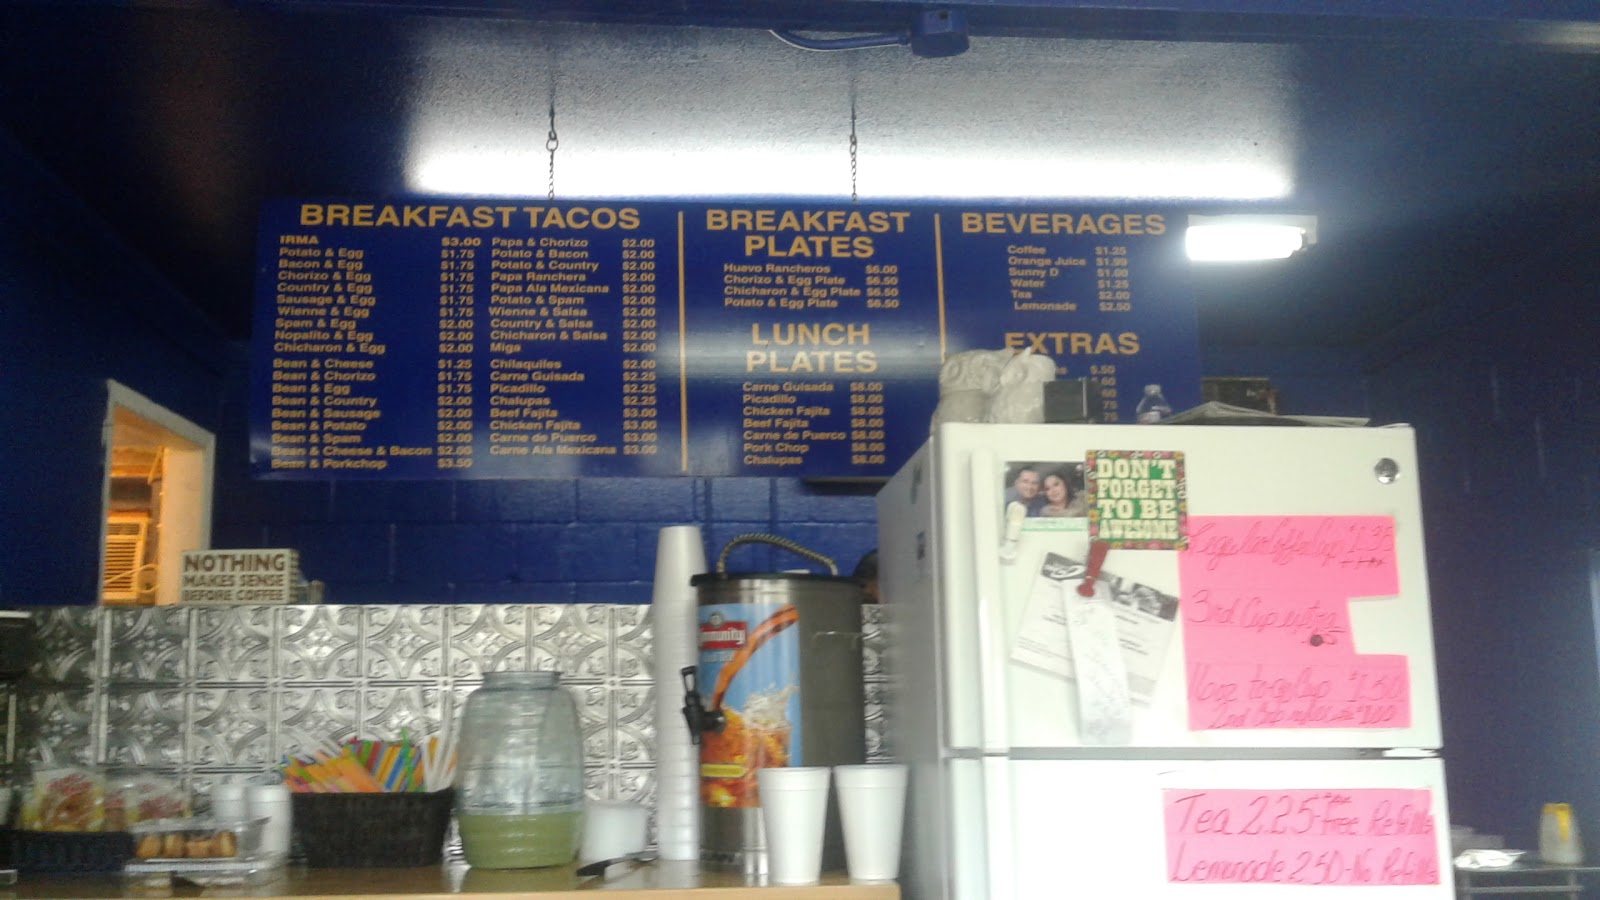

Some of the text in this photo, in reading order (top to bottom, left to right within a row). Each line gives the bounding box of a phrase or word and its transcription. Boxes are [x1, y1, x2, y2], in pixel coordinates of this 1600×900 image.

[301, 205, 640, 229] BREAKFAST TACOS
[706, 210, 910, 232] BREAKFAST
[961, 212, 1165, 235] BEVERAGES
[280, 235, 318, 245] IRMA
[491, 237, 588, 249] Papa & Chorizo
[745, 236, 874, 258] PLATES
[1008, 245, 1046, 255] Coffee
[279, 247, 364, 260] Potato & Egg
[491, 249, 589, 259] Potato & Bacon
[278, 259, 363, 272] Bacon & Egg
[491, 261, 599, 273] Potato & Country
[723, 263, 831, 274] Huevo Rancheros
[1008, 257, 1087, 269] Orange Juice
[277, 271, 372, 284] Chorizo & Egg
[491, 272, 586, 284] Papa Ranchera
[1008, 267, 1059, 279] Sunny D
[723, 275, 846, 287] Chorizo & Egg Plate
[1010, 279, 1045, 288] Water
[277, 283, 373, 295] Country & Egg
[490, 284, 609, 296] Papa Ala Mexicana
[1010, 290, 1032, 300] Tea
[276, 295, 377, 307] Sausage & Egg
[490, 295, 585, 308] Potato & Spam
[1014, 301, 1077, 311] Lemonade
[275, 318, 358, 331] Spam & Egg
[490, 319, 593, 331] Country & Salsa
[333, 330, 344, 340] &
[346, 331, 374, 343] Egg
[490, 331, 608, 341] Chicharon & Salsa
[752, 323, 870, 345] LUNCH
[274, 343, 386, 355] Chicharon & Egg
[1004, 332, 1139, 355] EXTRAS
[273, 359, 374, 369] Bean & Cheese
[490, 359, 561, 371] Chilaquiles
[745, 351, 878, 375] PLATES
[272, 371, 377, 381] Bean & Chorizo
[490, 371, 585, 381] Carne Guisada
[272, 383, 351, 396] Bean & Egg
[490, 384, 546, 393] Picadillo
[489, 396, 551, 408] Chalupas
[742, 394, 796, 404] Picadillo
[489, 408, 559, 420] Beef Fajita
[489, 420, 581, 433] Chicken Fajita
[743, 418, 810, 431] Beef Fajita
[744, 443, 809, 455] Pork Chop
[744, 455, 803, 467] Chalupas
[1096, 459, 1175, 479] DON'T
[1097, 480, 1176, 498] FORGET
[1098, 499, 1177, 519] TO BE
[1099, 520, 1178, 539] AWESOME
[184, 555, 285, 571] NOTHING
[184, 574, 284, 587] MAKES SENSE
[184, 590, 284, 601] BEFORE COFFEE
[1173, 792, 1232, 836] Tea
